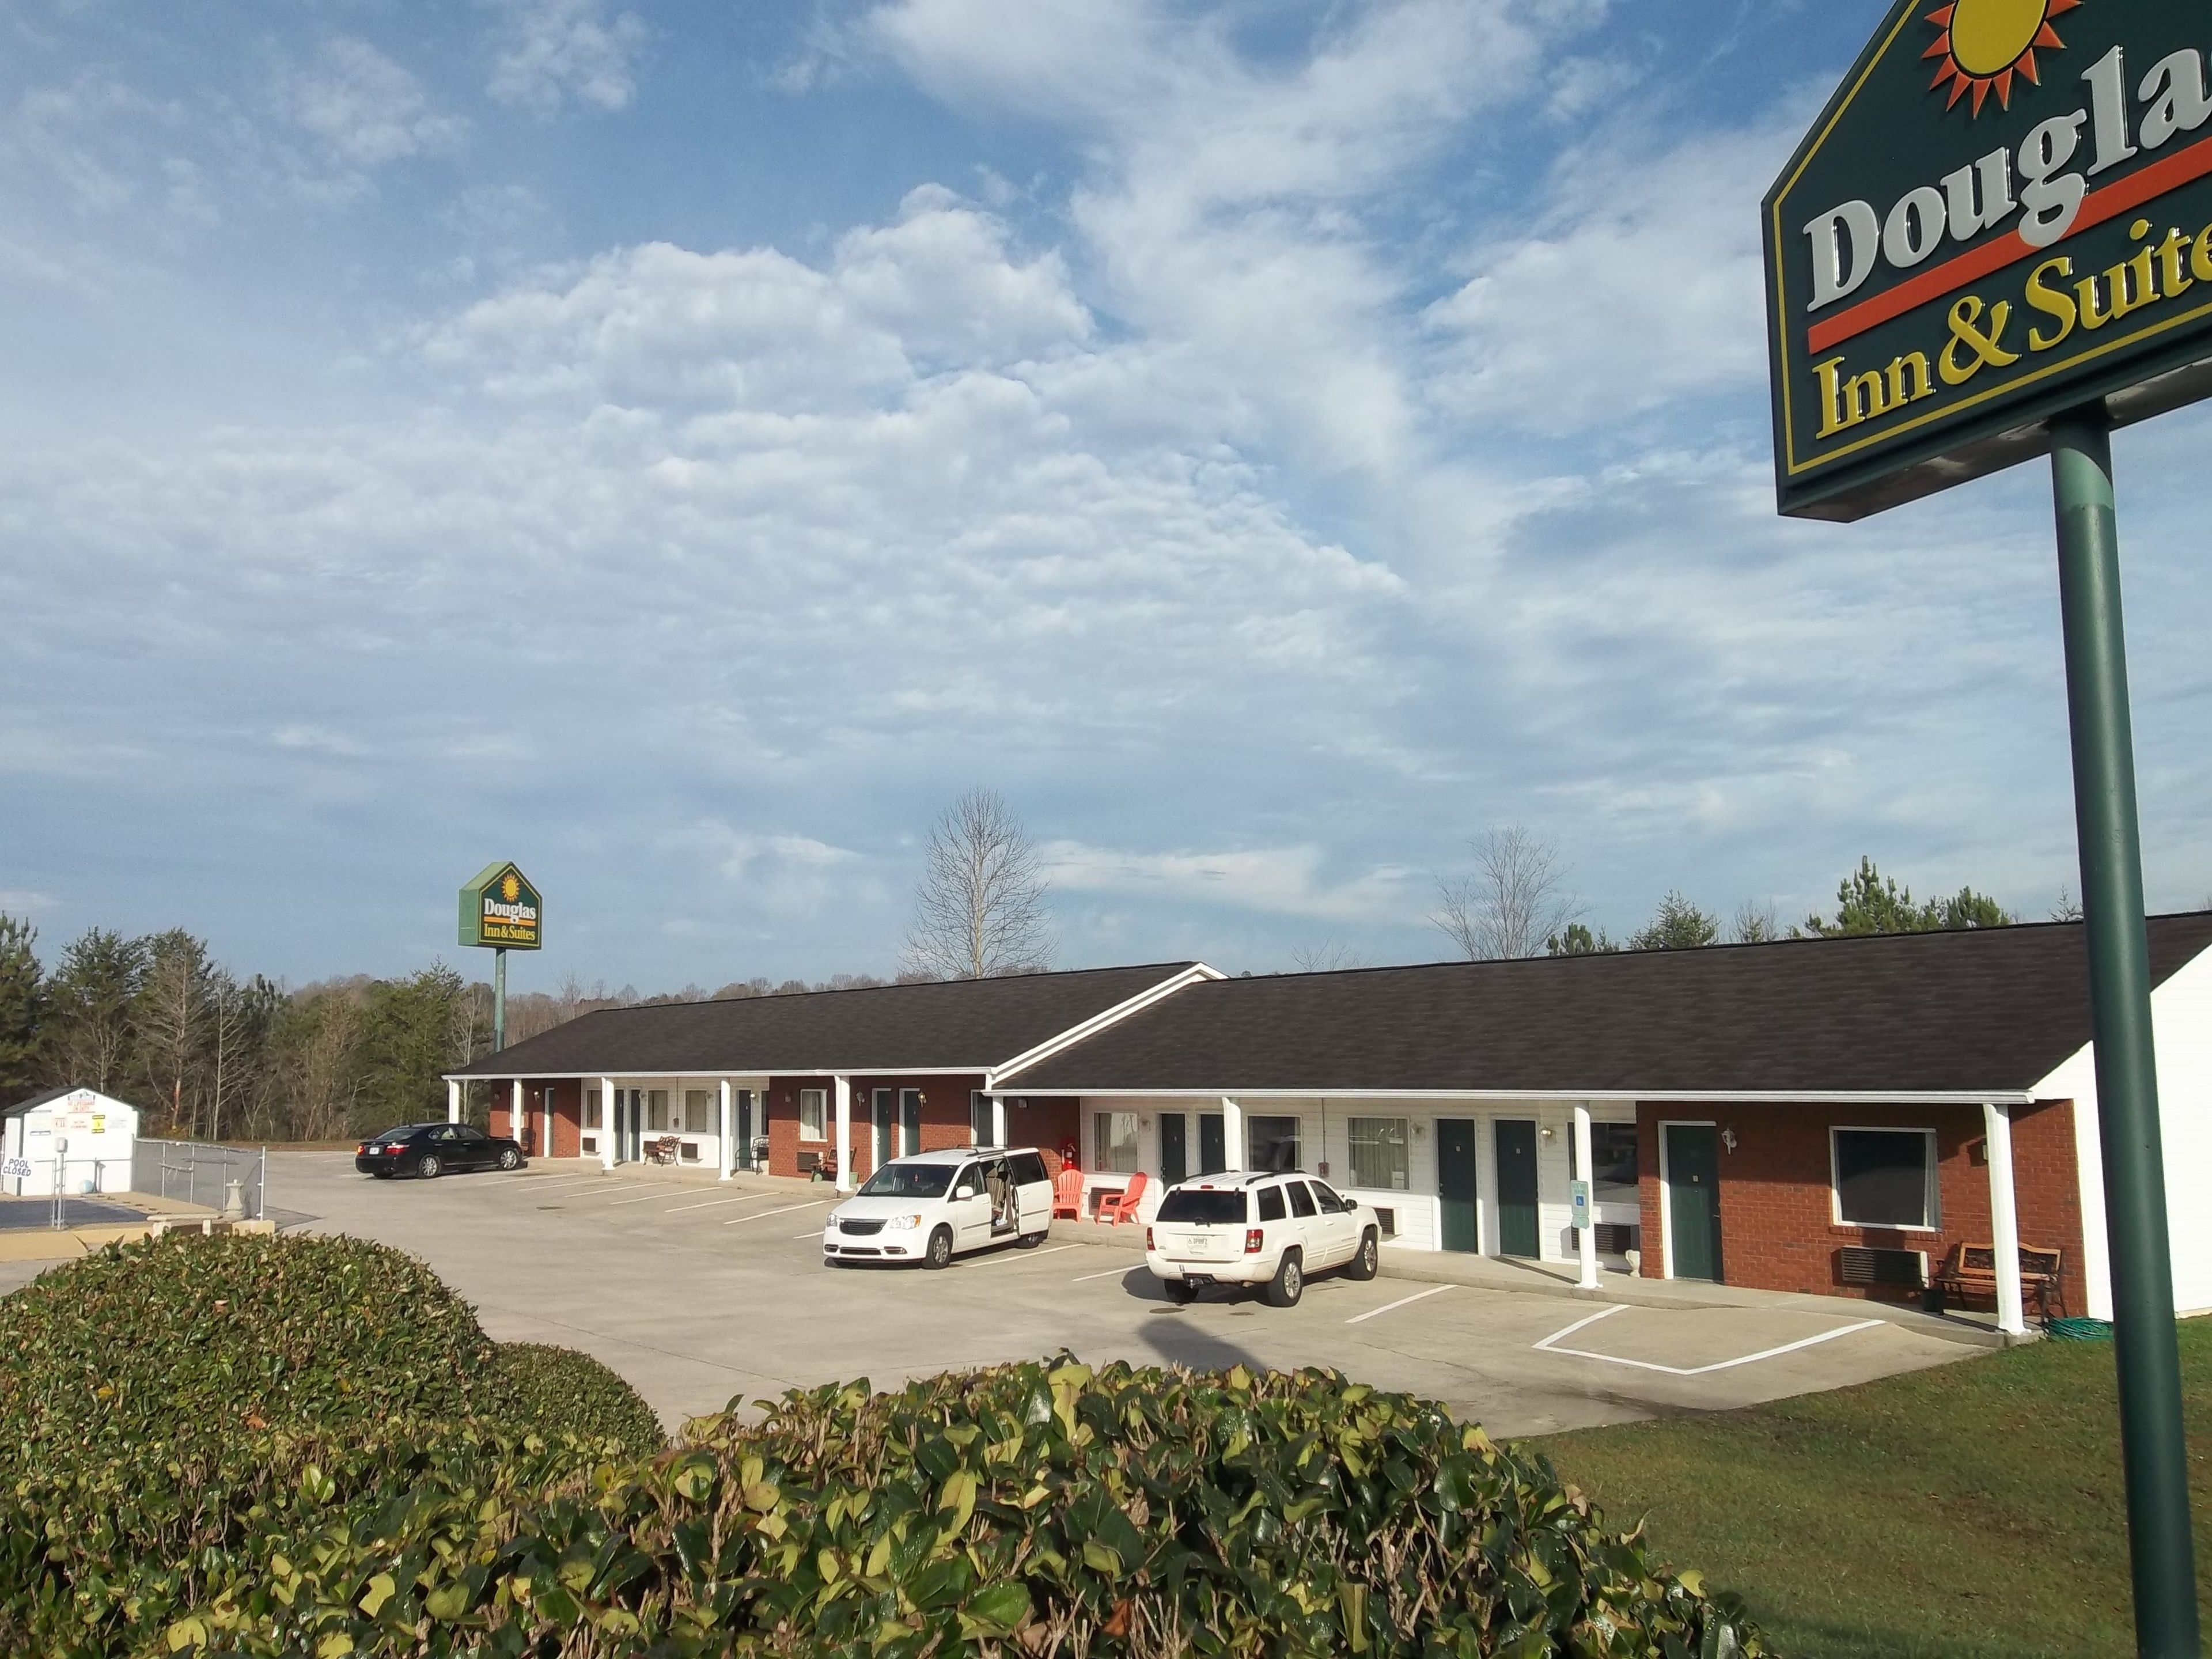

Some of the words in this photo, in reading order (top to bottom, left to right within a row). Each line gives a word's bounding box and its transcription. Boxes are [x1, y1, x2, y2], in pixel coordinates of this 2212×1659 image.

[1802, 44, 2212, 312] Dougla
[1812, 356, 1936, 440] Inn
[1938, 295, 2021, 385] &
[484, 898, 536, 924] Douglas
[484, 923, 500, 937] Inn
[501, 925, 509, 938] &
[509, 926, 535, 941] Suites
[3, 1166, 31, 1176] CLOSED
[9, 1158, 29, 1168] POOL
